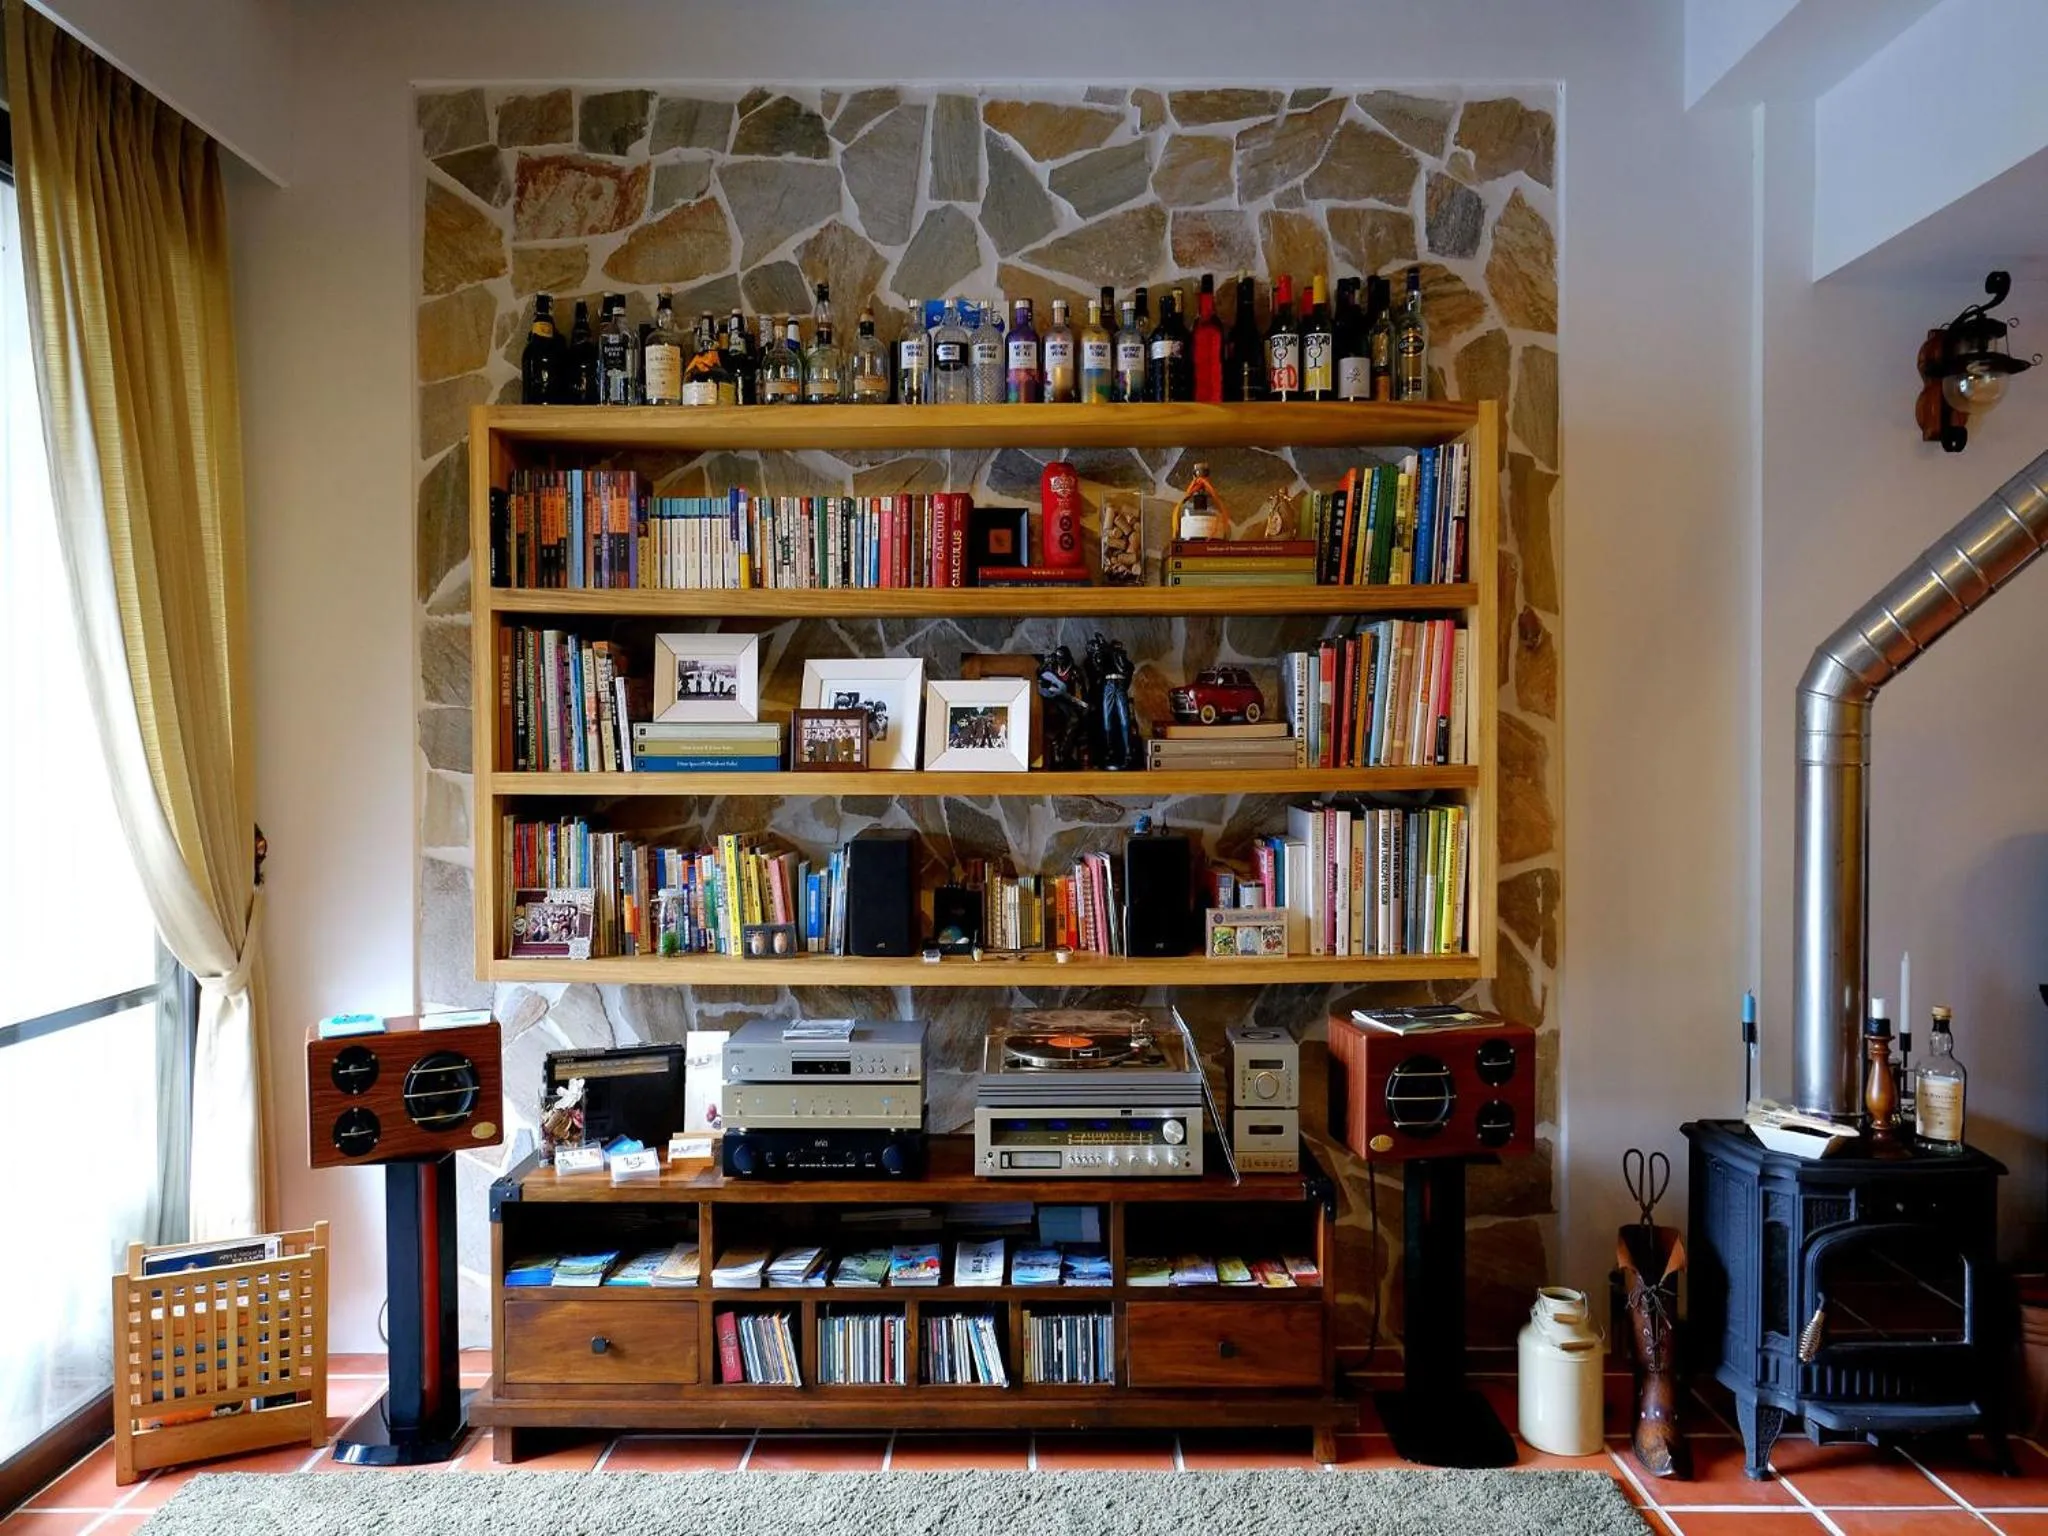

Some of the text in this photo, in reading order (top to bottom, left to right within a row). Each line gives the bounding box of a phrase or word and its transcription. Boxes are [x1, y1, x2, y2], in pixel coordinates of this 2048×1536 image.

[936, 502, 945, 561] CALCULUS
[952, 529, 962, 588] CALCULUS
[1297, 684, 1305, 752] IN THE CITY
